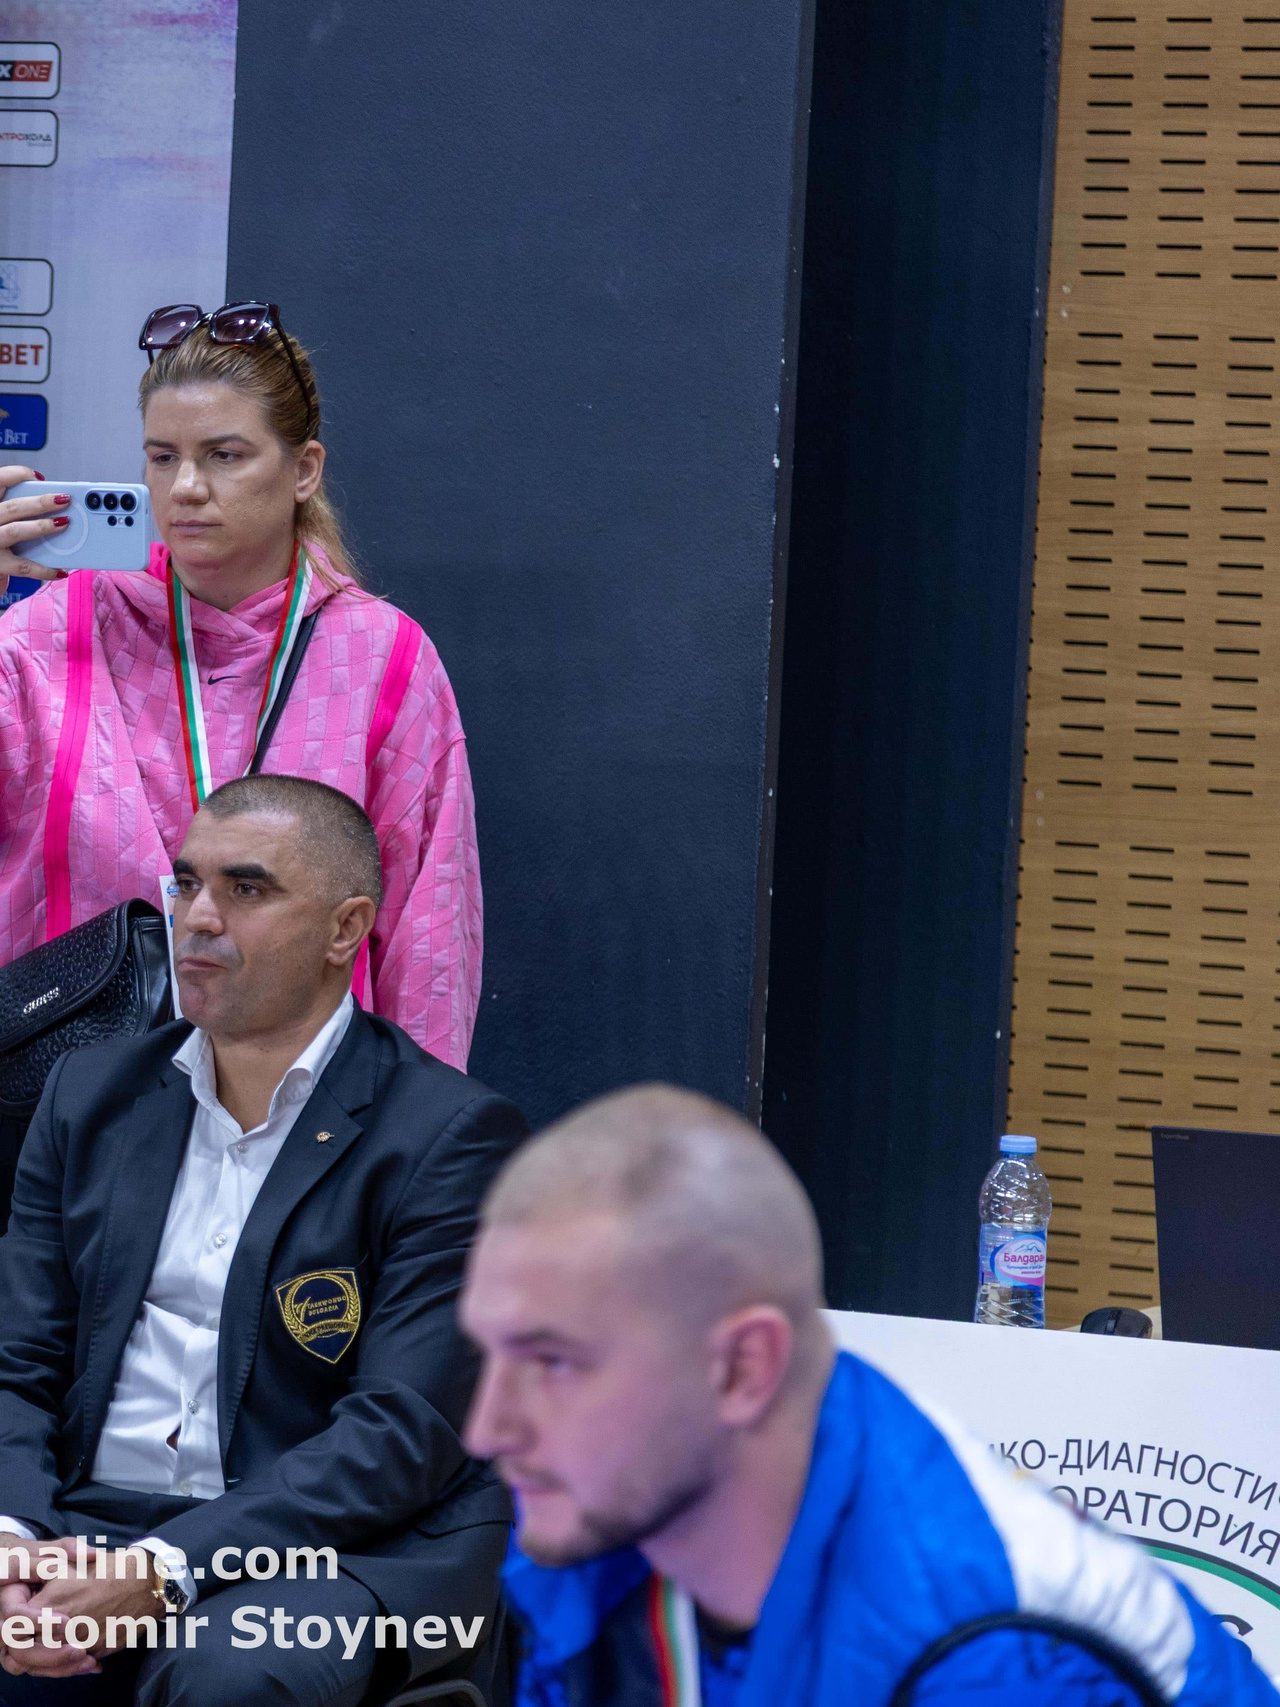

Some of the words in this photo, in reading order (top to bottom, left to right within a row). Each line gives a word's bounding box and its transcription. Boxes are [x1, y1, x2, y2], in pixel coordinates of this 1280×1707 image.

[5, 428, 29, 446] BET
[307, 1295, 347, 1309] TAEKWONDO
[989, 1438, 1280, 1512] КО-ДИАГНОСТИ
